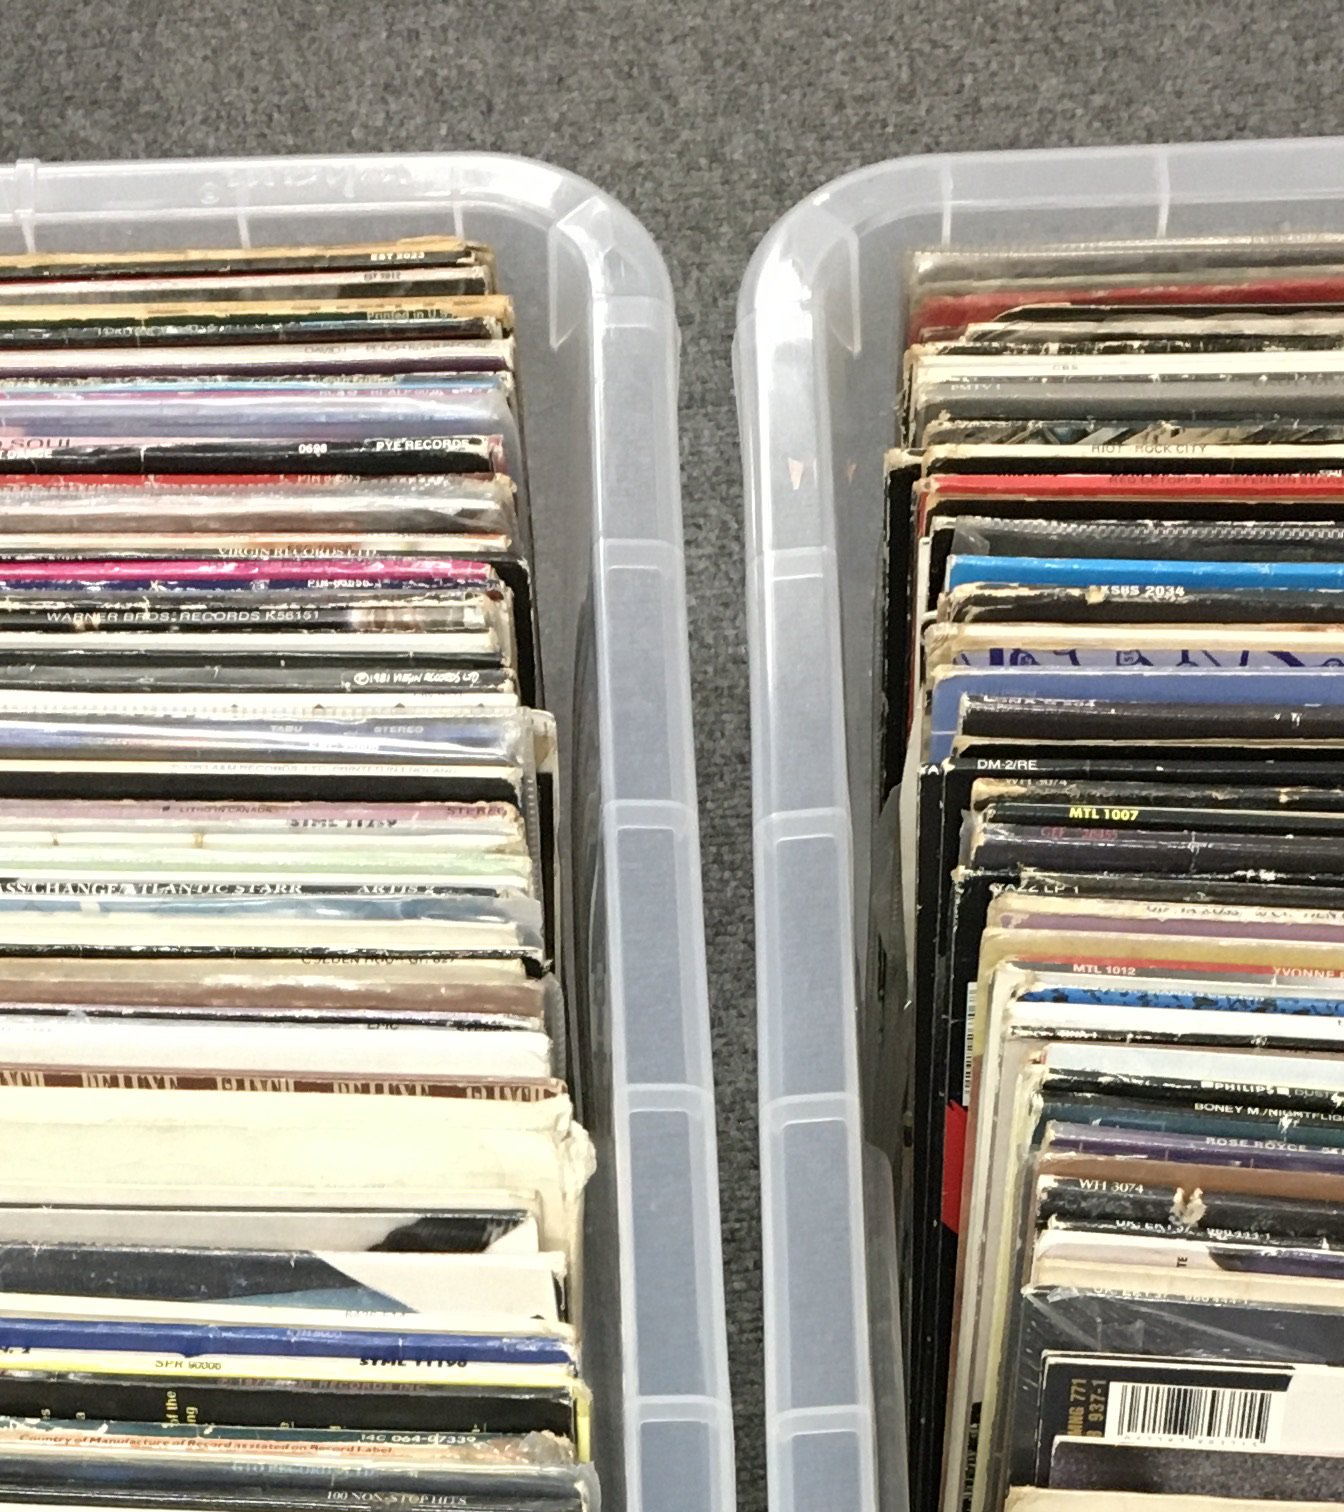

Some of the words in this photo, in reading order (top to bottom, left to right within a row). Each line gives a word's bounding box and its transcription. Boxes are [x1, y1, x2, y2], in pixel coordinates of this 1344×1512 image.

[375, 441, 402, 451] PYE
[403, 439, 471, 451] RECORDS
[1145, 586, 1185, 597] 2034
[47, 612, 119, 622] WARNER
[181, 611, 260, 622] RECORDS
[266, 611, 320, 621] K56151
[977, 760, 1038, 771] DM-2/RE
[1069, 807, 1100, 819] MTL
[1104, 809, 1139, 820] 1007
[1073, 964, 1102, 975] MTL
[1106, 966, 1136, 976] 1012
[1272, 967, 1336, 979] YVONNE
[1214, 1081, 1274, 1095] PHILIPS
[1194, 1102, 1243, 1113] BONEY
[1206, 1136, 1251, 1148] ROSE
[1255, 1140, 1307, 1153] ROYCE
[1079, 1178, 1108, 1190] WH
[1111, 1181, 1144, 1194] 3074
